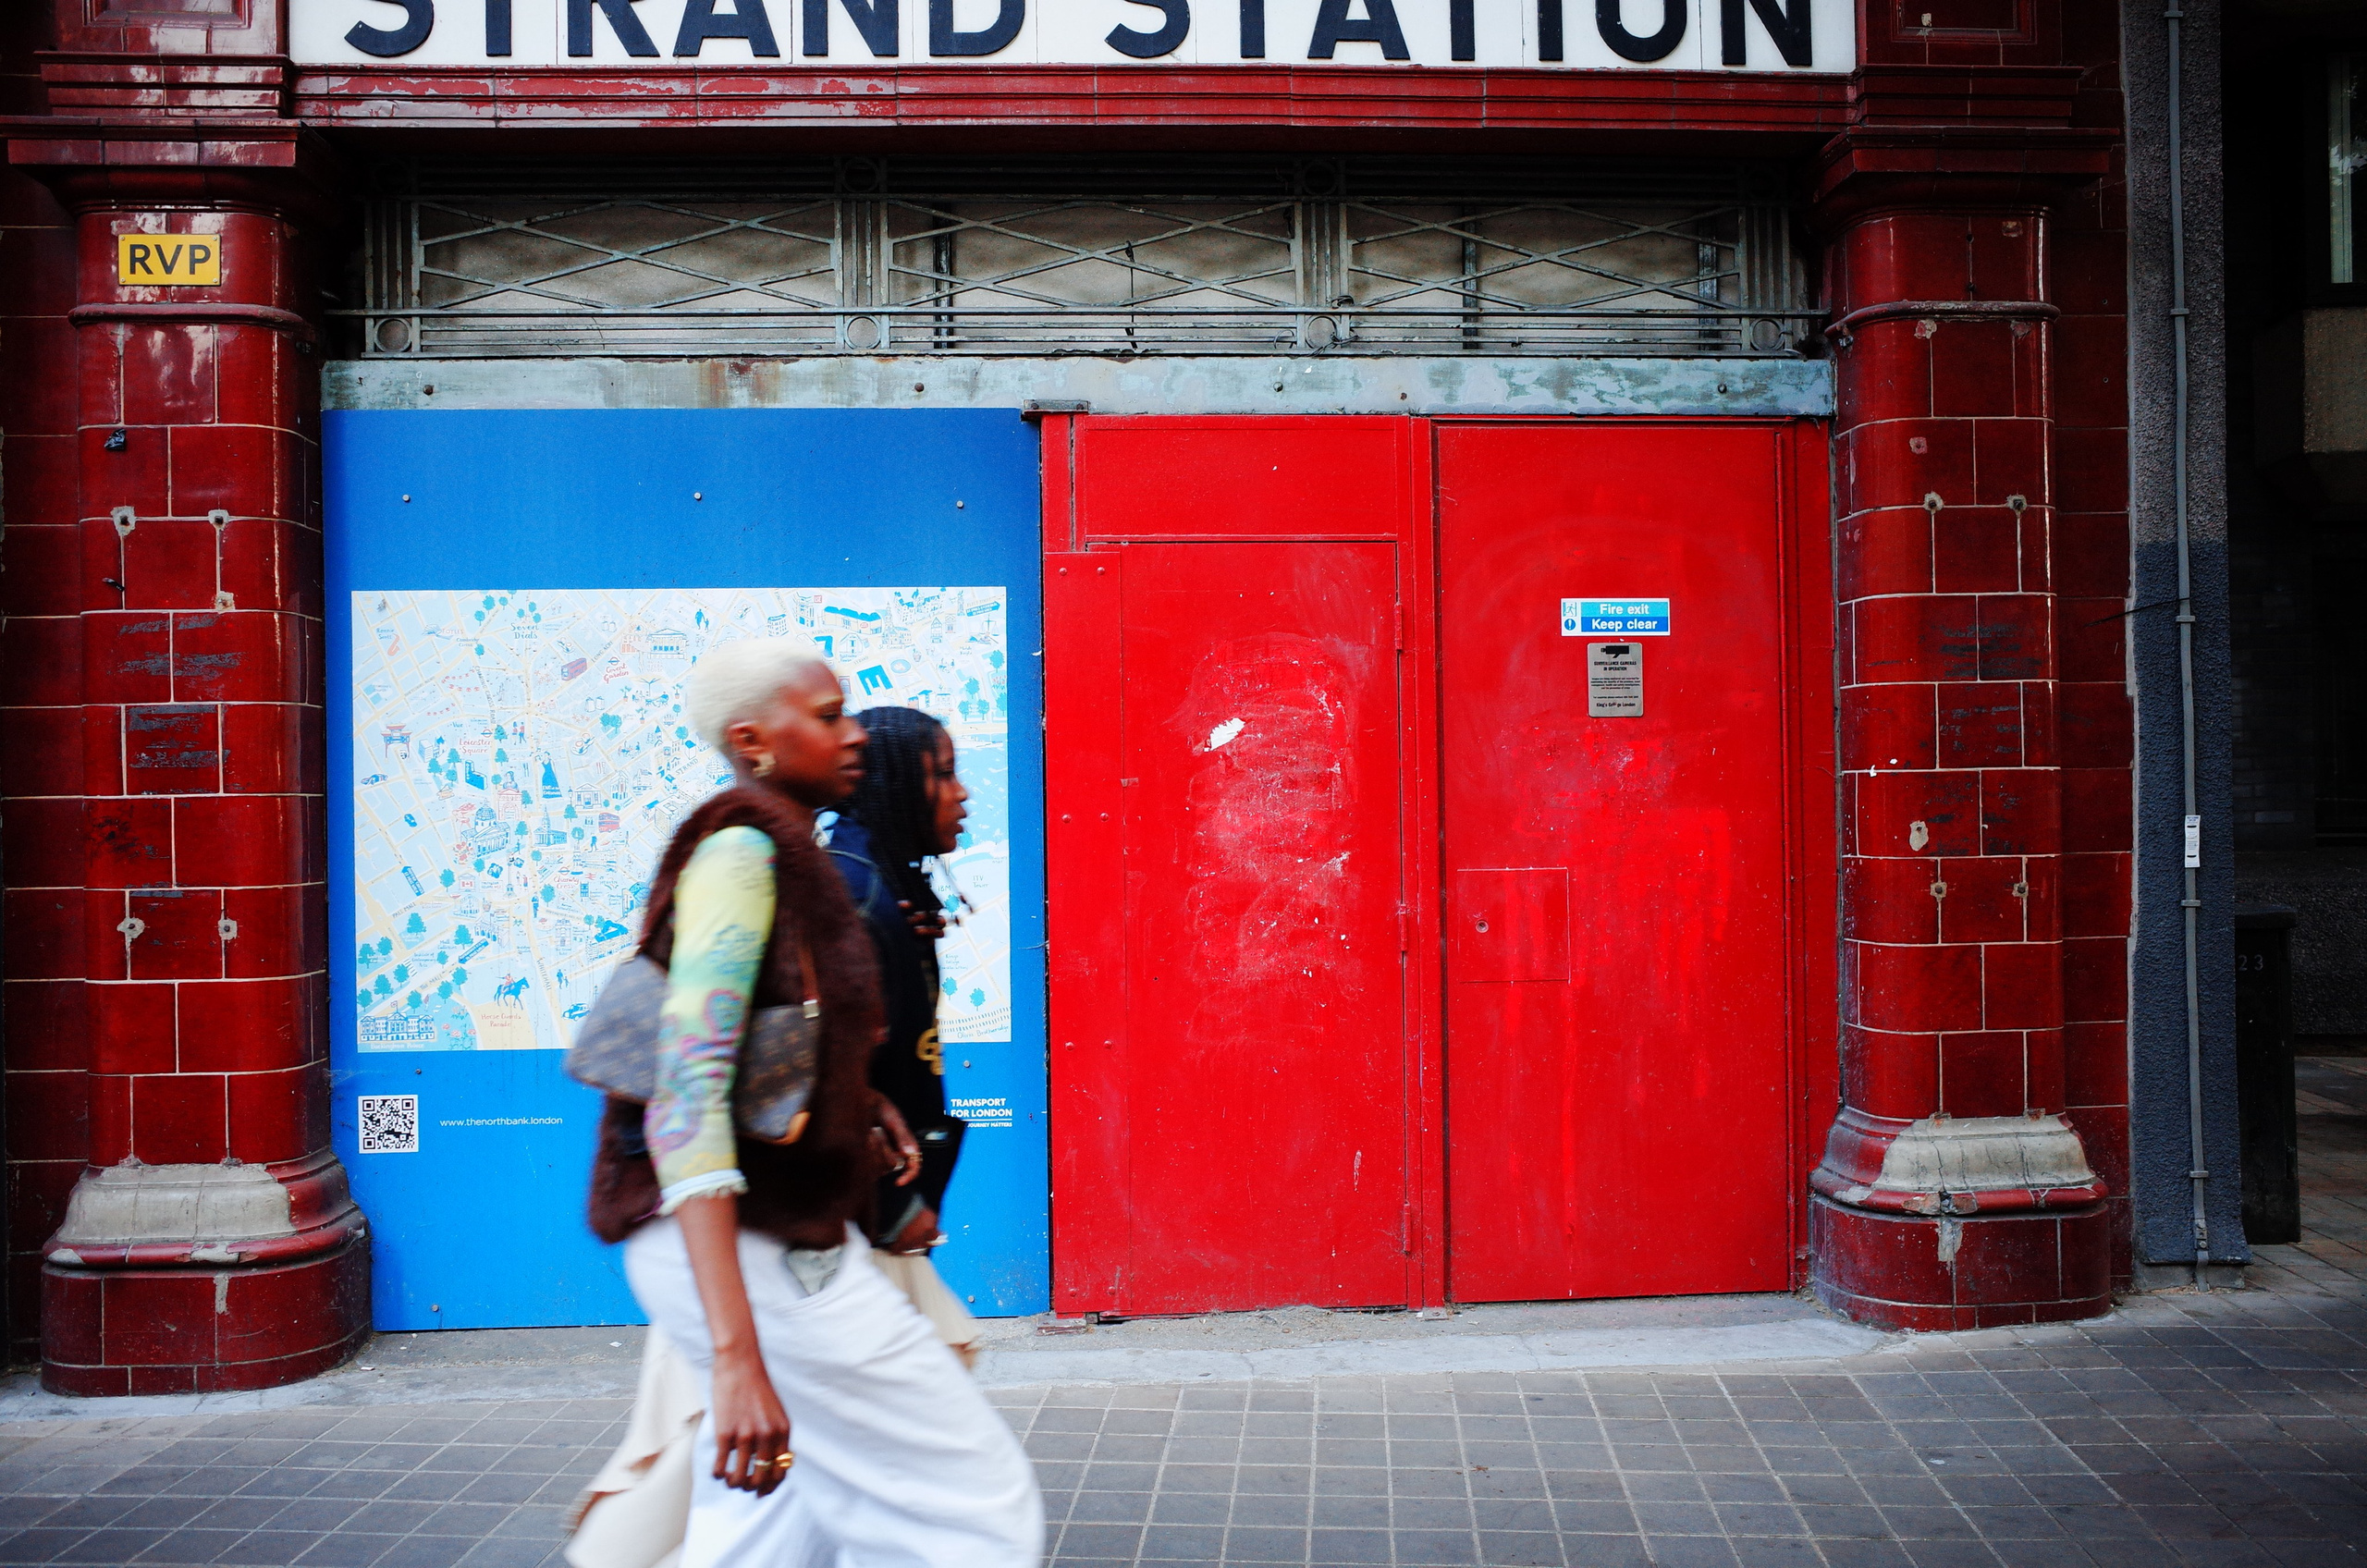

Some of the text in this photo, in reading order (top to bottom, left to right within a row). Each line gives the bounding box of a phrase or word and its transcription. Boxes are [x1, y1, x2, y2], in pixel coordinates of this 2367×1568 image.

[129, 244, 212, 275] RVP
[1600, 604, 1649, 614] Fire exit
[1592, 619, 1658, 631] Keep clear
[606, 663, 628, 673] Covent
[603, 671, 629, 684] Garden
[459, 738, 492, 746] Leicester
[461, 746, 488, 755] Square
[676, 758, 699, 775] STRAND
[535, 959, 552, 990] WHITEHALL
[950, 1098, 1006, 1108] TRANSPORT
[971, 1109, 1012, 1117] LONDON
[439, 1116, 563, 1127] www.thenorthbank.london
